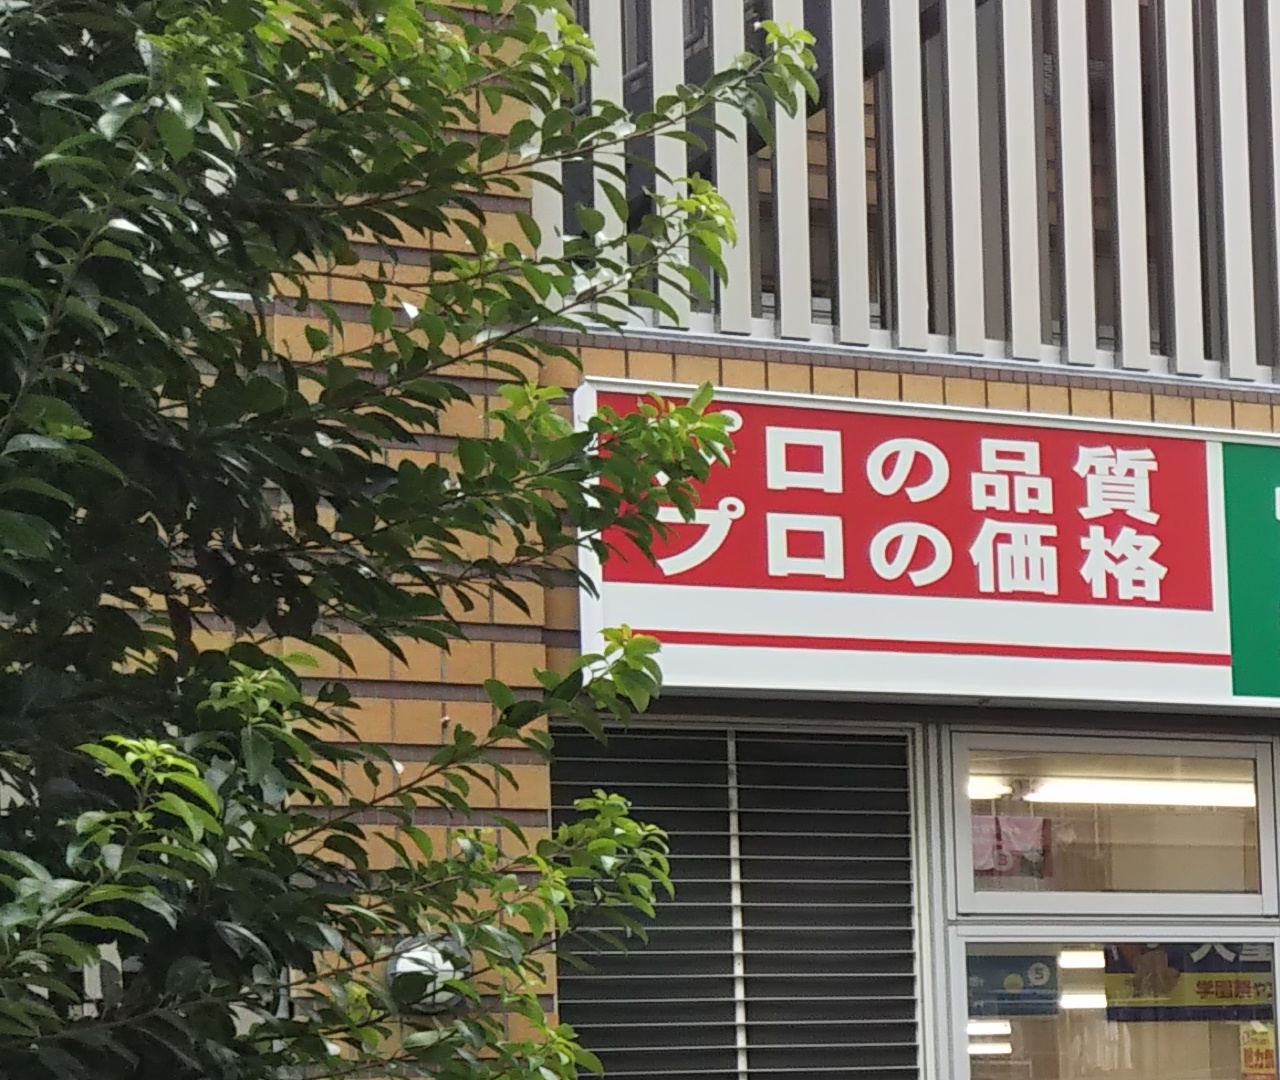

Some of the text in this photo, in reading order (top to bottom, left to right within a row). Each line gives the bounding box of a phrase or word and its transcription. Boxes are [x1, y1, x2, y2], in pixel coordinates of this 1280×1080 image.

[655, 497, 1168, 603] プロの価格
